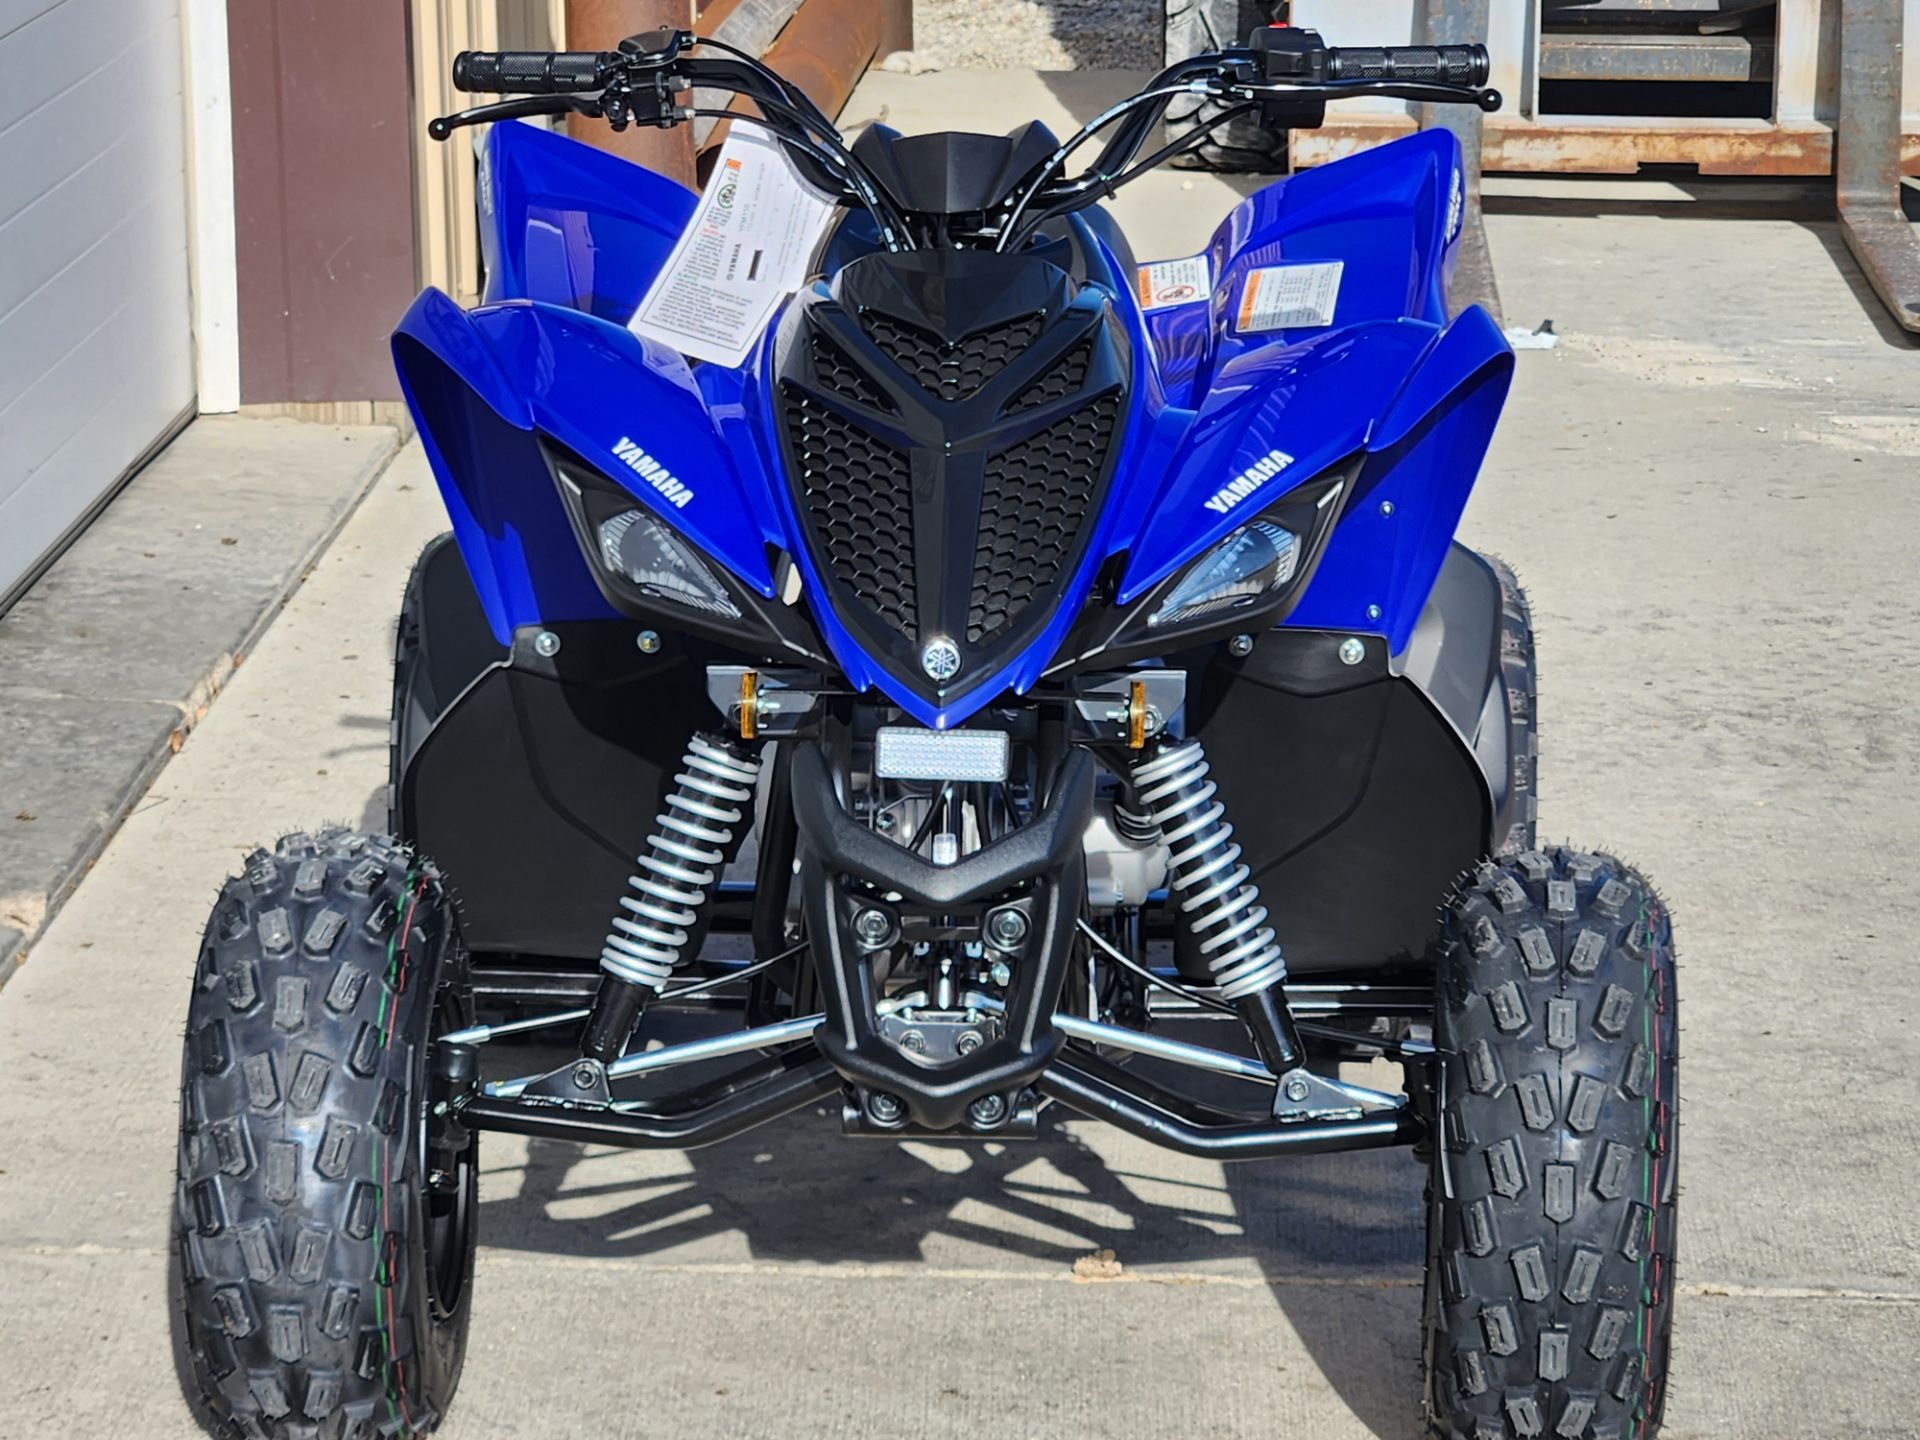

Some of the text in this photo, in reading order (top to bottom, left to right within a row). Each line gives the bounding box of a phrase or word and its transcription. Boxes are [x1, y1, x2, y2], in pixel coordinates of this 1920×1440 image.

[728, 243, 742, 274] YAMAHA
[611, 436, 694, 508] YAMAHA
[1203, 449, 1295, 513] YAMAHA
